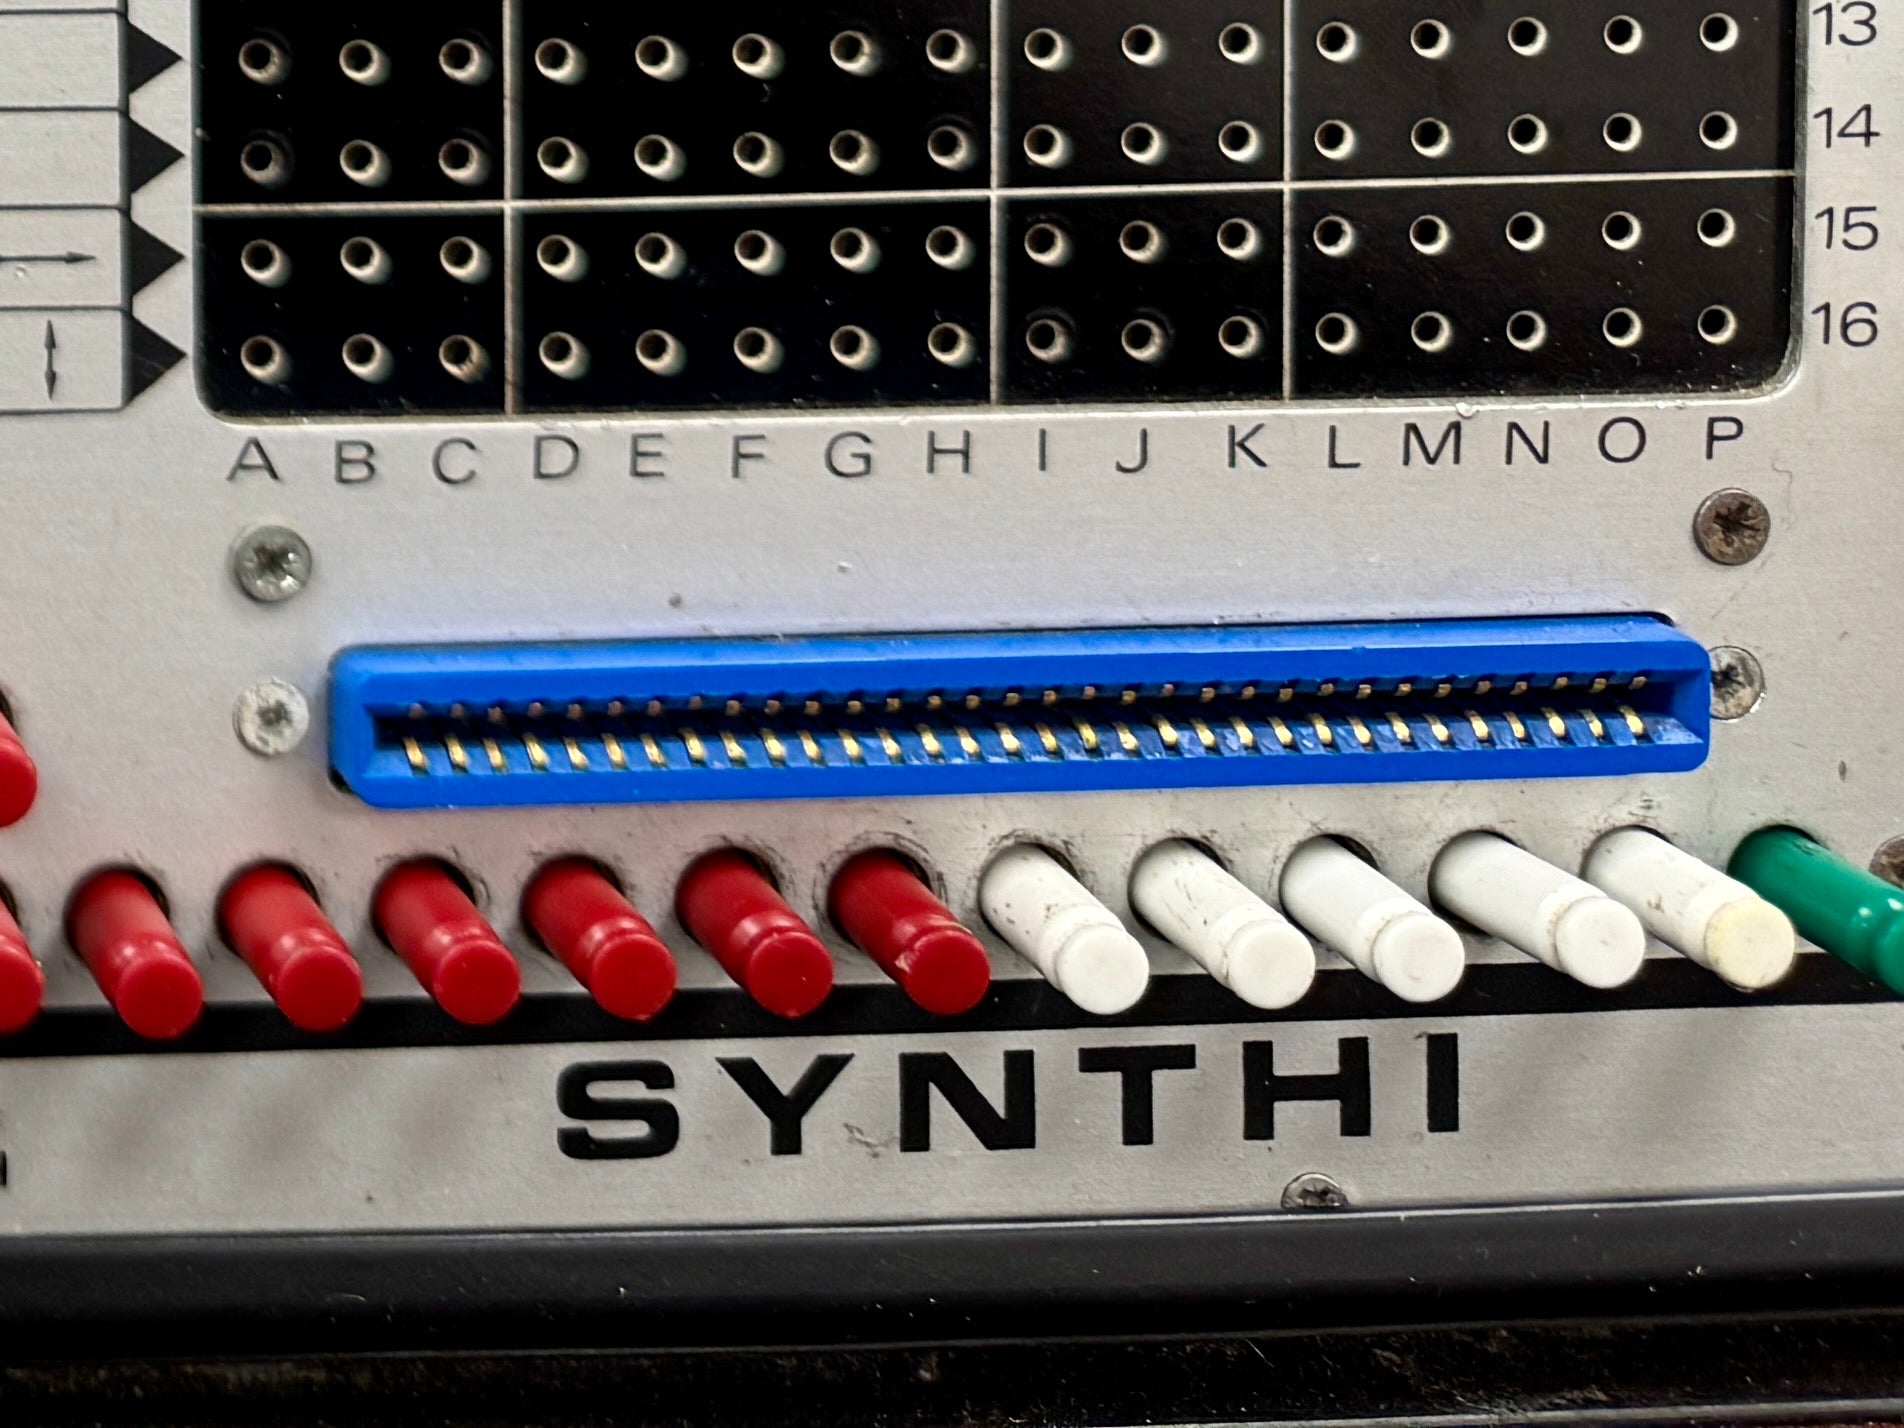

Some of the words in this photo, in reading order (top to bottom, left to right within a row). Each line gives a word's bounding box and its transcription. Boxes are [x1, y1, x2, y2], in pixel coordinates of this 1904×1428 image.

[1813, 104, 1881, 149] 14
[1811, 301, 1878, 347] 16
[226, 437, 283, 483] A
[432, 438, 478, 487] C
[533, 434, 581, 481] D
[825, 431, 874, 479] G
[1228, 423, 1268, 468] K
[1403, 420, 1462, 467] M
[1706, 416, 1744, 460] P
[556, 1031, 1460, 1162] SYNTHI
